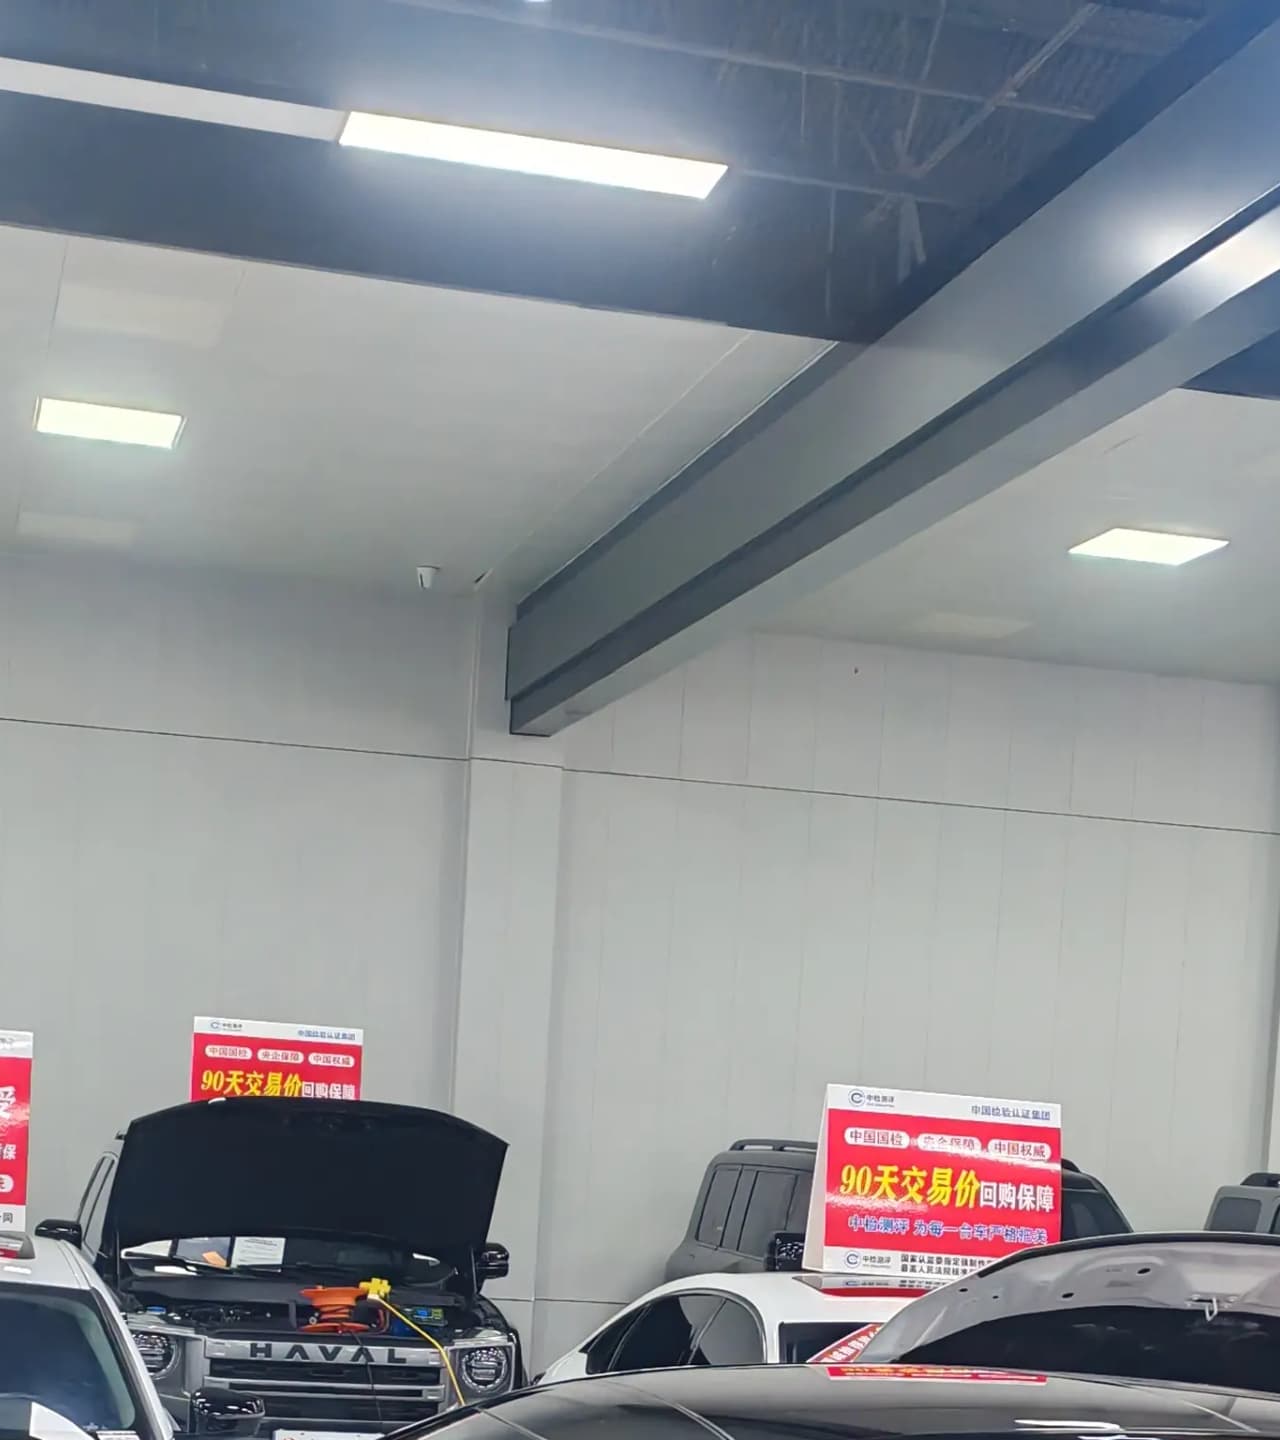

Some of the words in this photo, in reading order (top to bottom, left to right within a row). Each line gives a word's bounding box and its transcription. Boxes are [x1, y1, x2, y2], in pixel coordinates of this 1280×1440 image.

[849, 1129, 904, 1146] 中国国检
[993, 1141, 1046, 1158] 中国权威
[839, 1164, 1055, 1213] 90天交易价回购保障
[848, 1214, 910, 1235] 中检测评
[249, 1343, 407, 1364] HAVAL
